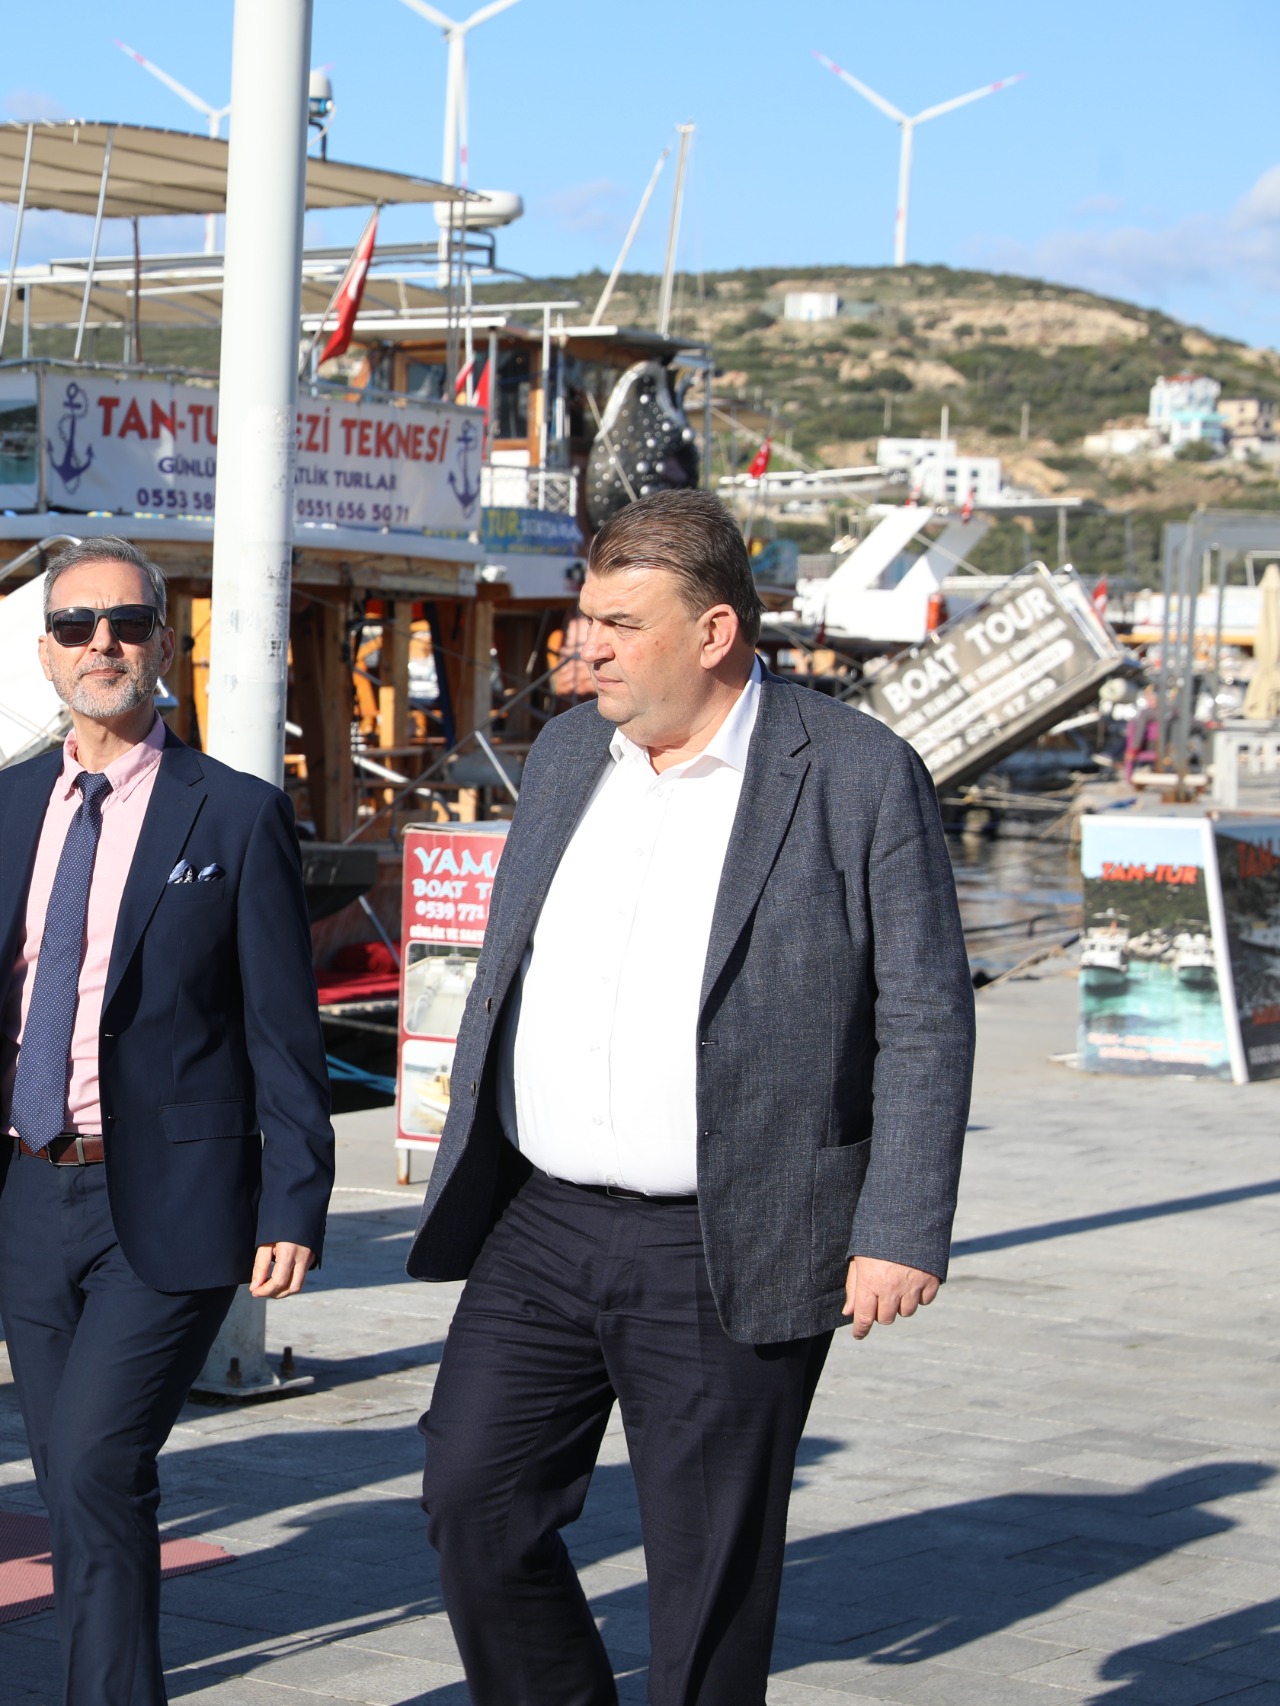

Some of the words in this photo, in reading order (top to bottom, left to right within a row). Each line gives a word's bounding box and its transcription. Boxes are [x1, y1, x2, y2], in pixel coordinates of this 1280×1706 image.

[341, 417, 451, 464] TEKNESİ
[334, 470, 396, 491] TURLAR
[136, 487, 188, 508] 0553
[193, 492, 216, 511] 58
[297, 498, 332, 518] 0551
[337, 501, 365, 521] 656
[372, 503, 392, 522] 50
[881, 642, 960, 714] BOAT
[964, 587, 1055, 656] TOUR
[413, 846, 501, 878] YAM
[1102, 860, 1198, 885] TAN-TUR
[412, 878, 468, 899] BOAT
[475, 882, 493, 901] T
[415, 899, 456, 920] 0539
